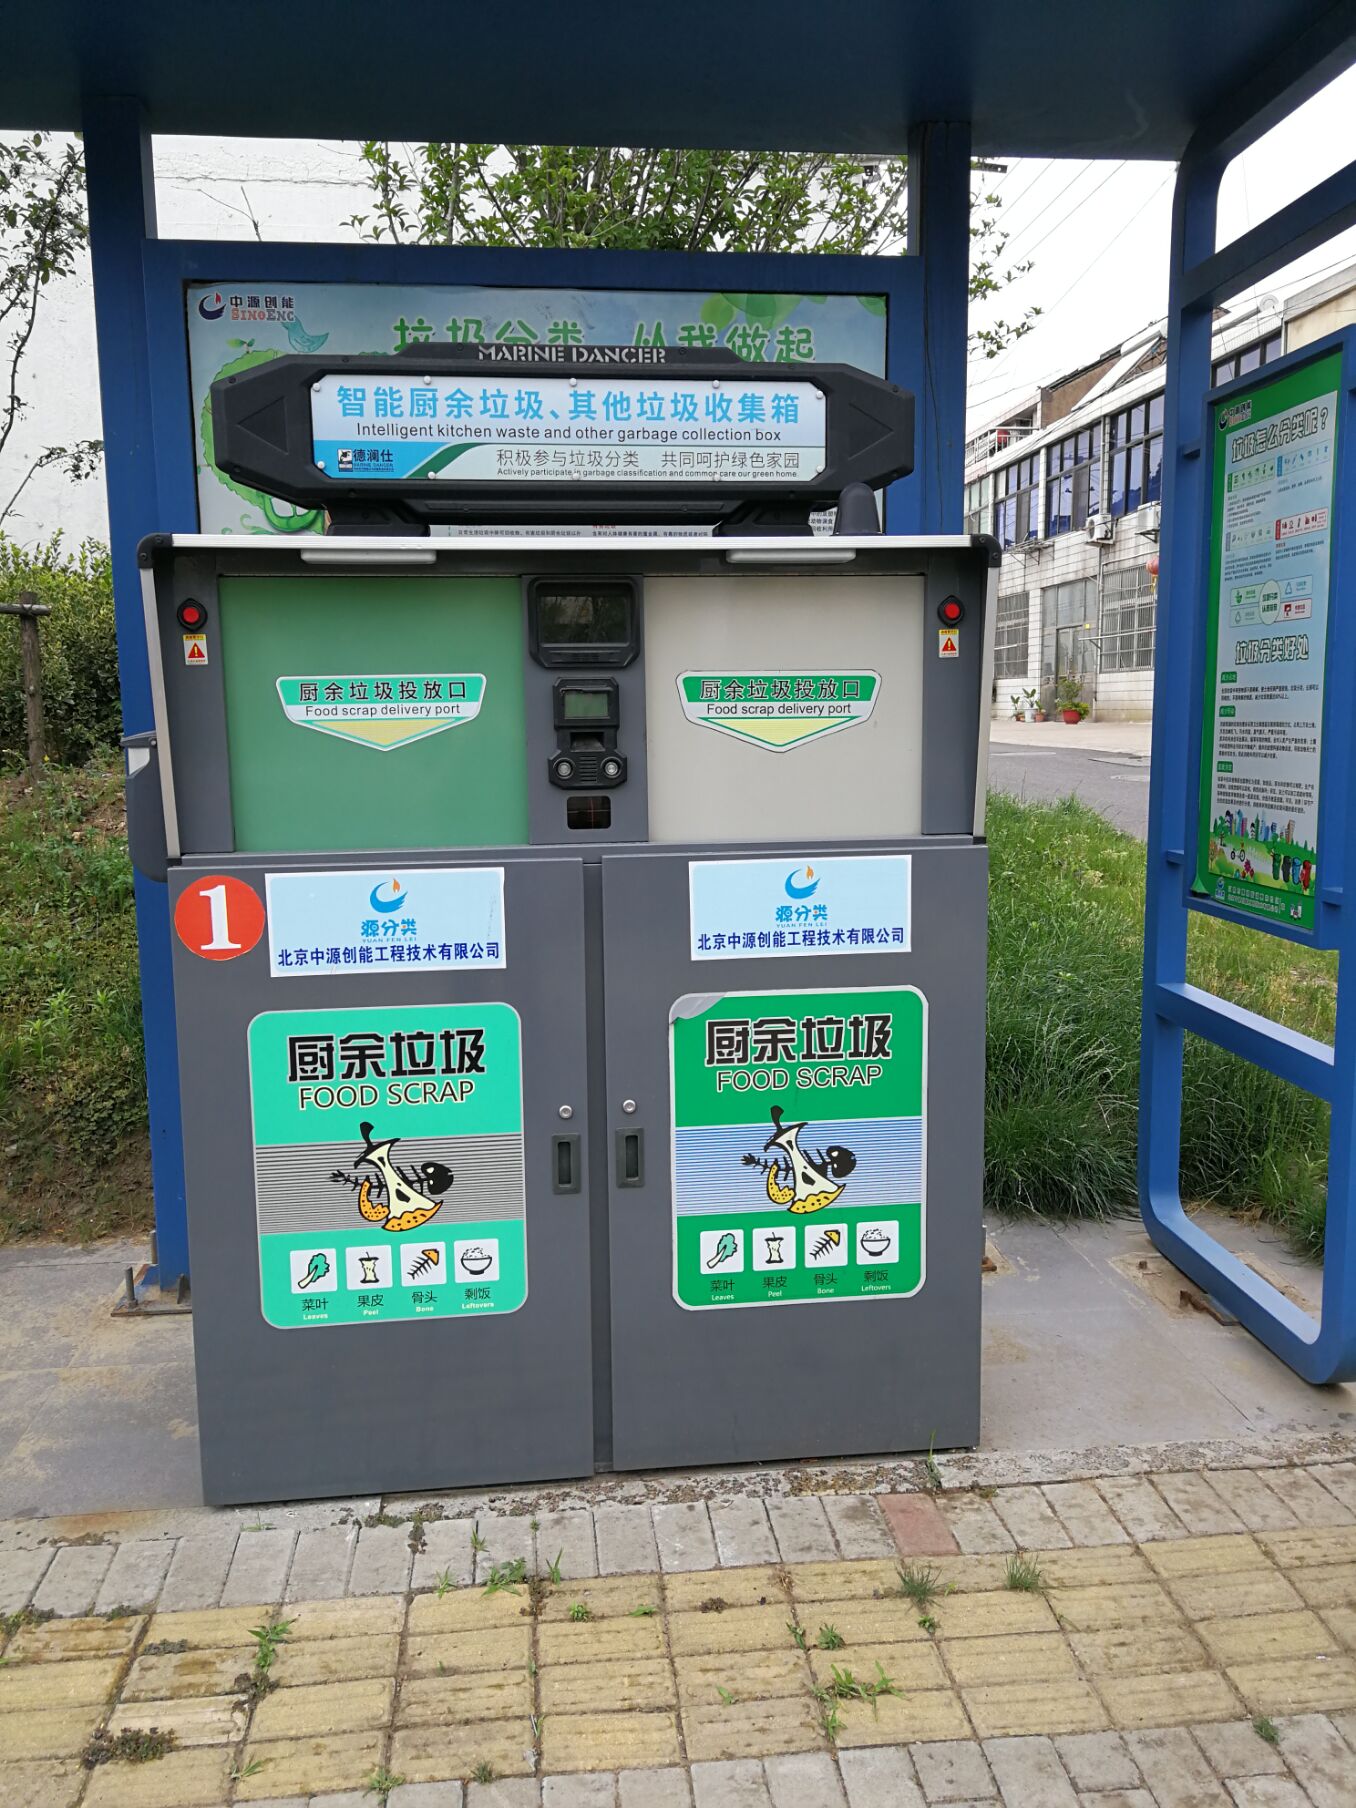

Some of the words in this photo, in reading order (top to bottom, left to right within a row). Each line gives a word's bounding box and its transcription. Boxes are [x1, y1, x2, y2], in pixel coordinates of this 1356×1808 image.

[230, 295, 294, 308] 中源创能
[478, 345, 564, 362] MARINE
[572, 346, 665, 364] DANCER
[337, 385, 800, 424] 智能厨余垃圾、其他垃圾收集箱
[357, 422, 433, 440] Intelligent
[437, 424, 492, 438] kitchen
[496, 427, 539, 440] waste
[544, 426, 571, 439] and
[576, 427, 614, 440] other
[618, 427, 678, 443] garbage
[682, 427, 751, 441] collection
[756, 428, 781, 441] box
[496, 449, 639, 467] 积极参与垃圾分类
[661, 451, 799, 468] 共同呵护绿色家园
[497, 468, 528, 476] Actively
[531, 468, 572, 477] participate
[617, 469, 667, 477] classification
[752, 471, 774, 479] green
[776, 470, 797, 478] home
[1235, 633, 1309, 665] 垃圾分类好处
[299, 680, 466, 702] 厨余垃圾投放口
[700, 678, 861, 701] 厨余垃圾投放口
[306, 704, 338, 716] Food
[342, 706, 377, 718] scrap
[381, 703, 430, 718] delivery
[435, 703, 460, 716] port
[707, 703, 738, 714] Food
[741, 705, 774, 717] scrap
[778, 702, 825, 717] delivery
[828, 703, 852, 716] port
[199, 884, 241, 951] 1
[775, 903, 828, 923] 源分类
[361, 918, 417, 937] 源分类
[697, 927, 904, 950] 北京中源创能工程技术有限公司
[278, 941, 500, 967] 北京中源创能工程技术有限公司
[705, 1014, 892, 1067] 厨余垃圾
[288, 1028, 486, 1083] 厨余垃圾
[717, 1070, 789, 1092] FOOD
[797, 1065, 882, 1089] SCRAP
[299, 1085, 378, 1110] FOOD
[387, 1081, 474, 1106] SCRAP
[763, 1276, 787, 1289] 果皮
[814, 1273, 837, 1285] 骨头
[864, 1269, 888, 1282] 剩饭
[464, 1287, 490, 1301] 剩饭
[710, 1279, 735, 1292] 菜叶
[861, 1283, 891, 1292] Leftovers
[302, 1298, 328, 1311] 菜叶
[357, 1294, 384, 1308] 果皮
[411, 1290, 438, 1304] 骨头
[462, 1301, 494, 1309] Leftovers
[303, 1312, 328, 1320] Leaves
